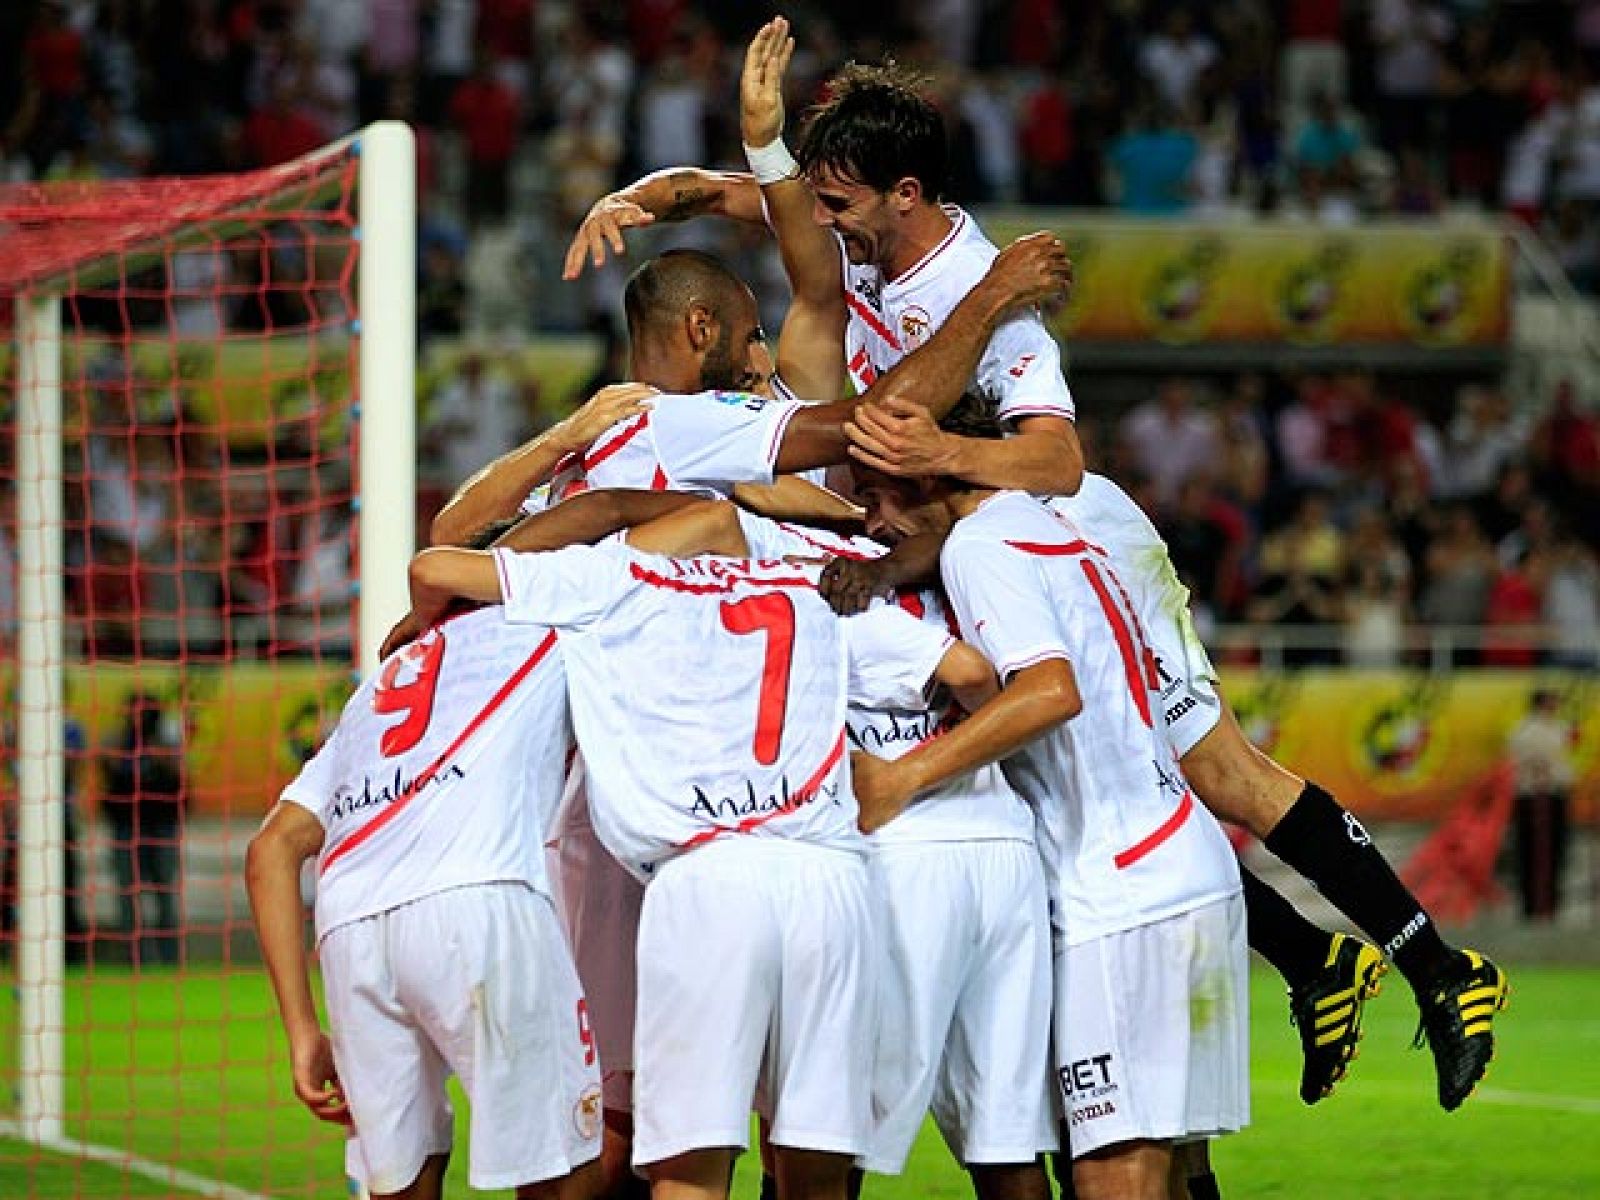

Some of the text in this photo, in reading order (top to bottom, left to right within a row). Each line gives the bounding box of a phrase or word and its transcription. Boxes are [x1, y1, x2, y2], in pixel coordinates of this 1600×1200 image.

[370, 630, 446, 758] 9
[720, 590, 796, 766] 7
[577, 997, 597, 1067] 9
[1060, 1052, 1112, 1096] BET
